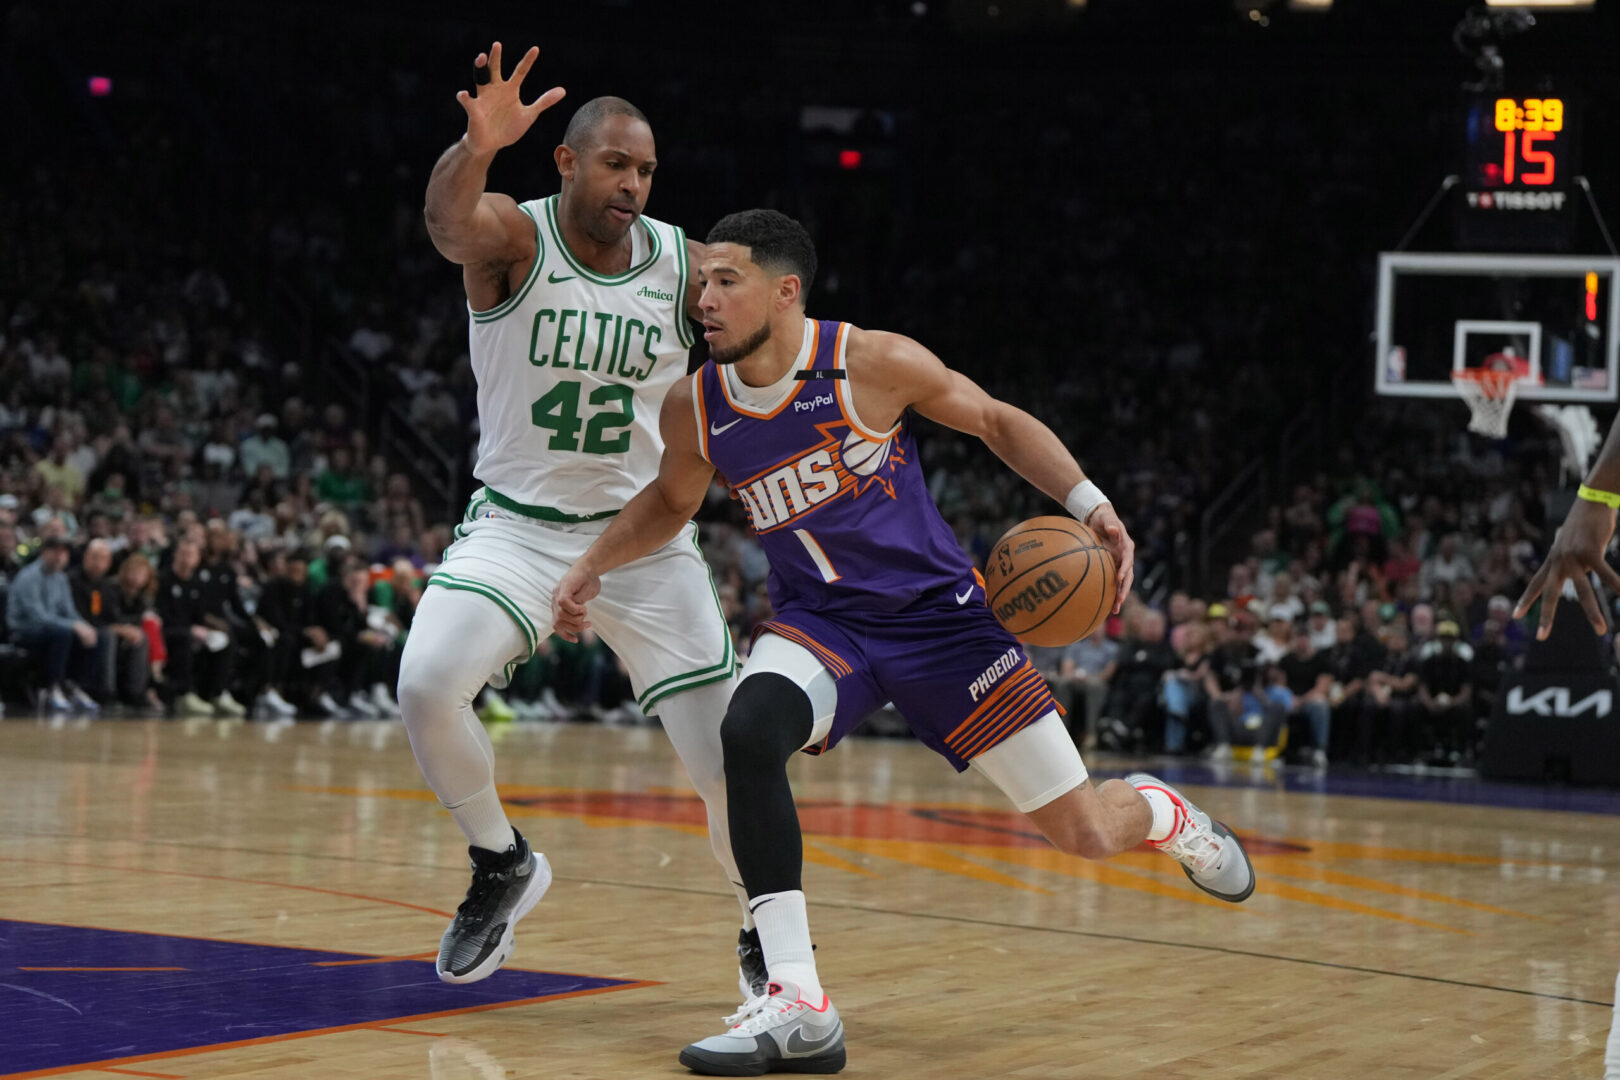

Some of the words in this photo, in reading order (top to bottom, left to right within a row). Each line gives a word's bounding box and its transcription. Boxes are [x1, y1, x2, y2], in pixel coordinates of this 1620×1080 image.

[1495, 98, 1563, 132] 8:39
[1503, 130, 1556, 185] 15
[636, 285, 674, 302] Amica
[528, 308, 662, 381] CELTICS
[793, 392, 834, 412] PayPal
[815, 370, 824, 379] AL
[531, 380, 635, 454] 42
[737, 449, 840, 531] UNS
[792, 528, 842, 583] 1
[995, 569, 1070, 624] Wilson
[968, 647, 1021, 702] PHOENIX
[1506, 685, 1613, 718] KIA
